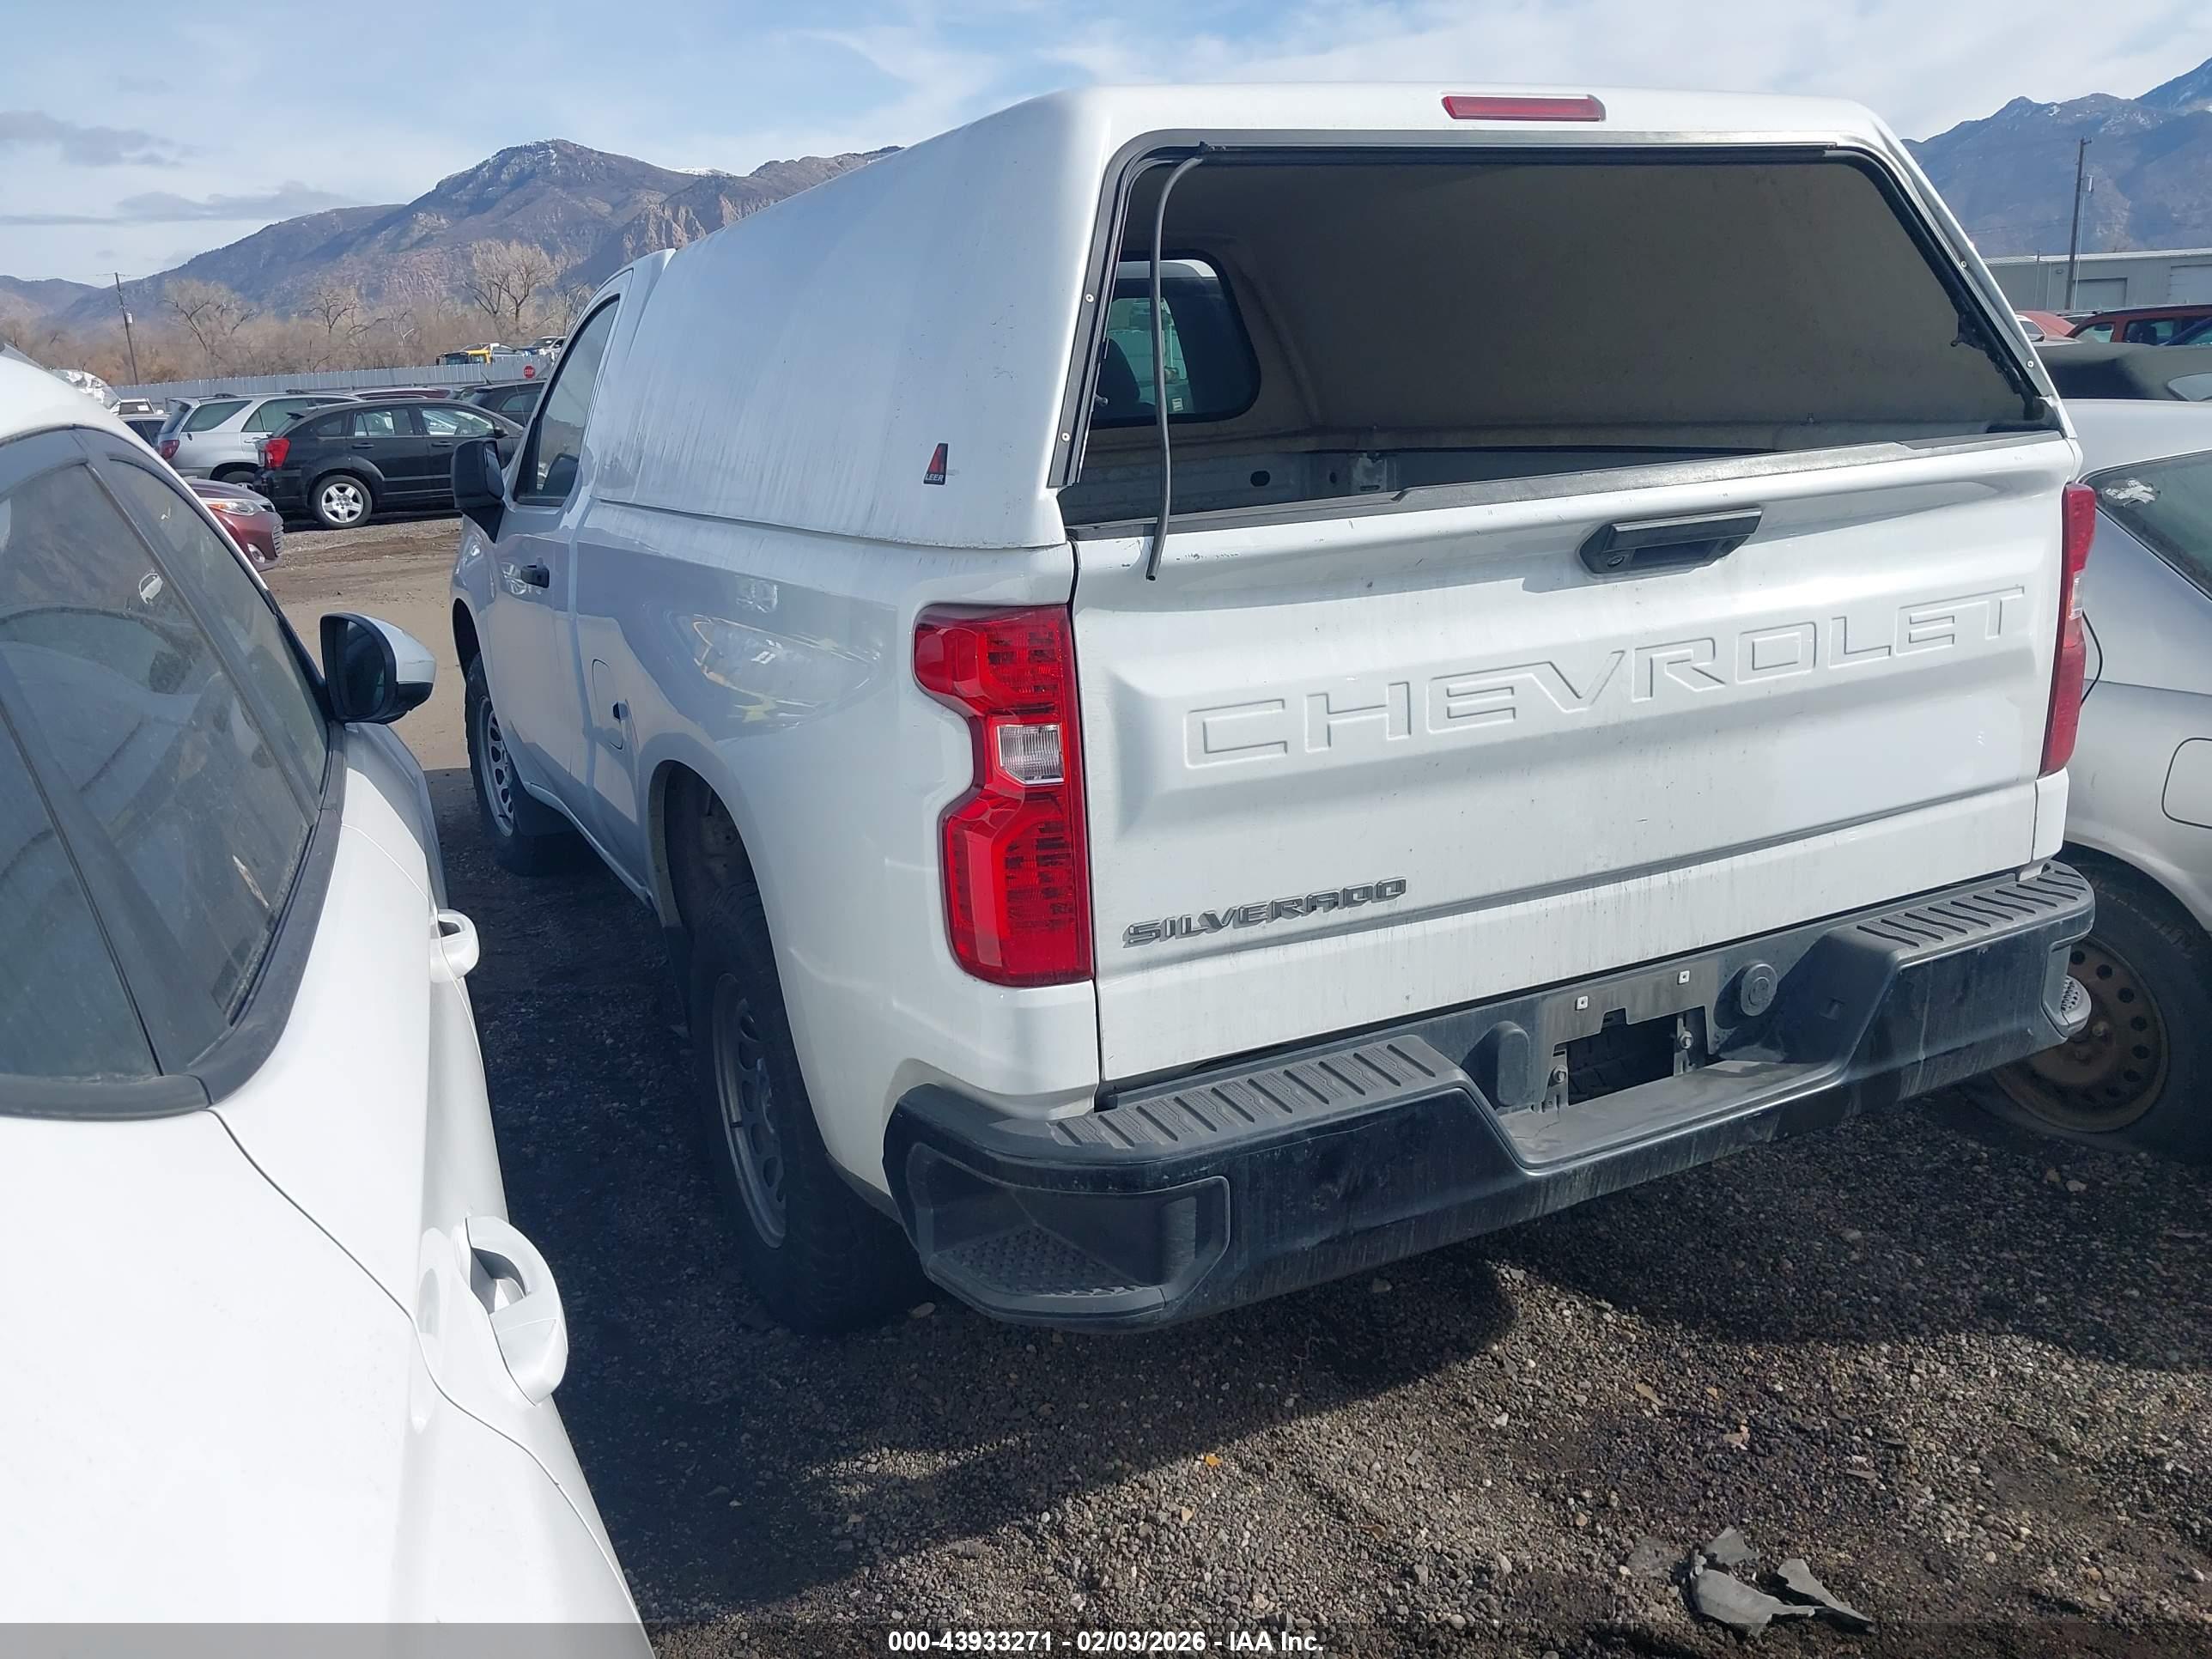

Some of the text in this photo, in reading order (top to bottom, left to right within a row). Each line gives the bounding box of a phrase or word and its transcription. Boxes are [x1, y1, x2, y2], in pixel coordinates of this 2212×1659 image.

[925, 473, 945, 482] LEER
[1185, 585, 2026, 770] CHEVROLET
[1121, 876, 1408, 949] SILVERADO
